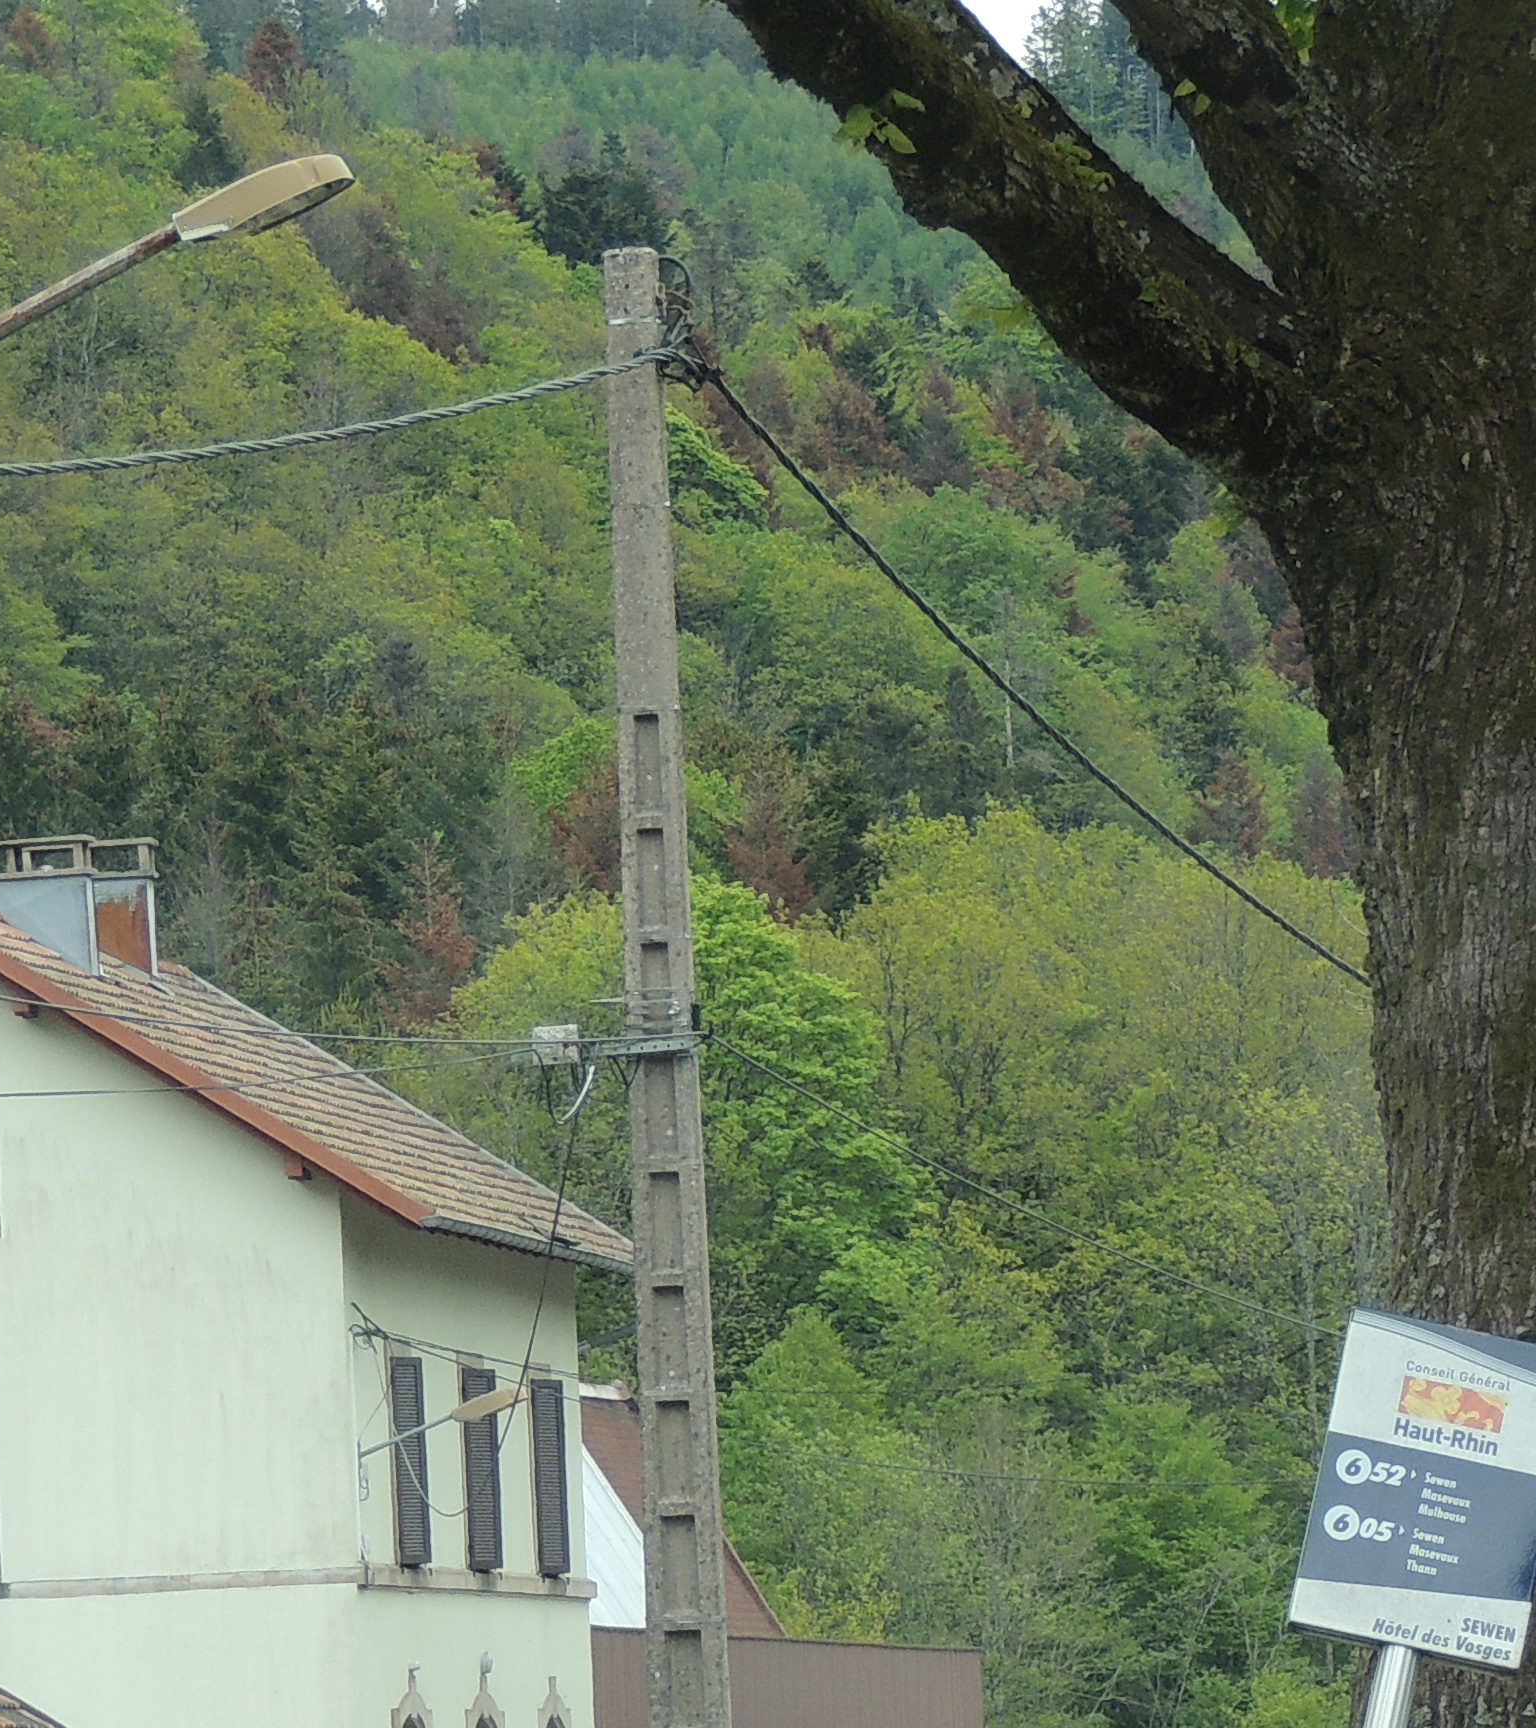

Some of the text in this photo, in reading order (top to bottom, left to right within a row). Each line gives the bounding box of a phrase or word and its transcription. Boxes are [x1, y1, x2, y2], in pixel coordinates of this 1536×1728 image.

[1406, 1360, 1511, 1392] Conseil Général
[1393, 1417, 1499, 1456] Haut-Rhin
[1339, 1452, 1458, 1489] 652 Sewen
[1420, 1487, 1471, 1508] Masevaux
[1327, 1508, 1446, 1545] 605 Sewen
[1417, 1503, 1468, 1524] Mulhouse
[1406, 1559, 1438, 1576] Thann
[1408, 1543, 1460, 1564] Masevaux
[1372, 1617, 1512, 1661] Hôtel des Vosges
[1461, 1617, 1517, 1643] SEWEN
